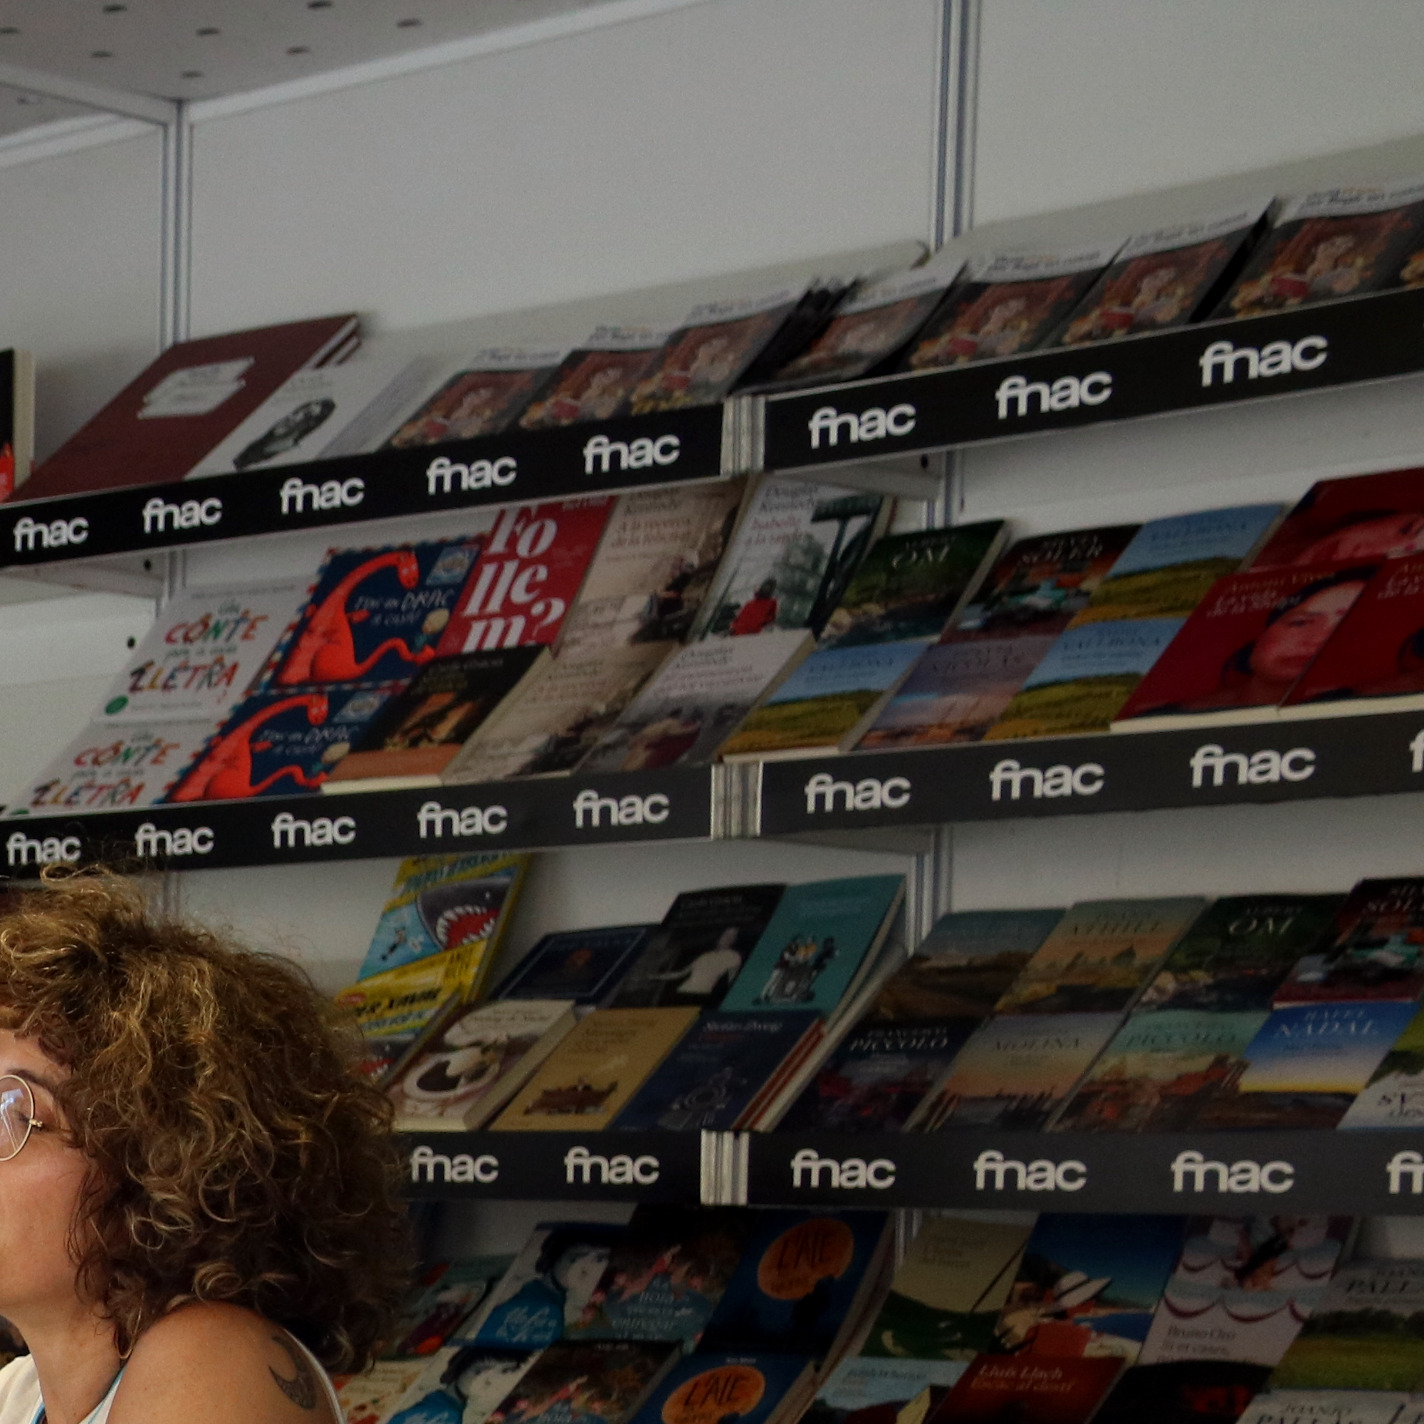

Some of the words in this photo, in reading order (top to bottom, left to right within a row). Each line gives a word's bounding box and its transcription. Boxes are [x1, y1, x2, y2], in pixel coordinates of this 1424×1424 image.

[808, 404, 915, 448] fnac
[996, 372, 1112, 418] fnac
[1200, 336, 1327, 386] fnac
[13, 517, 88, 551] fnac
[143, 498, 222, 533] fnac
[280, 478, 364, 514] fnac
[427, 457, 516, 494] fnac
[583, 435, 679, 474] fnac
[805, 774, 910, 813] fnac
[990, 760, 1104, 800] fnac
[1190, 745, 1315, 787] fnac
[7, 833, 81, 865] fnac
[135, 823, 213, 857] fnac
[272, 813, 355, 847] fnac
[417, 802, 507, 838] fnac
[573, 790, 669, 827] fnac
[410, 1146, 498, 1182] fnac
[564, 1147, 659, 1184] fnac
[791, 1149, 895, 1188] fnac
[974, 1150, 1086, 1191] fnac
[1171, 1151, 1294, 1193] fnac
